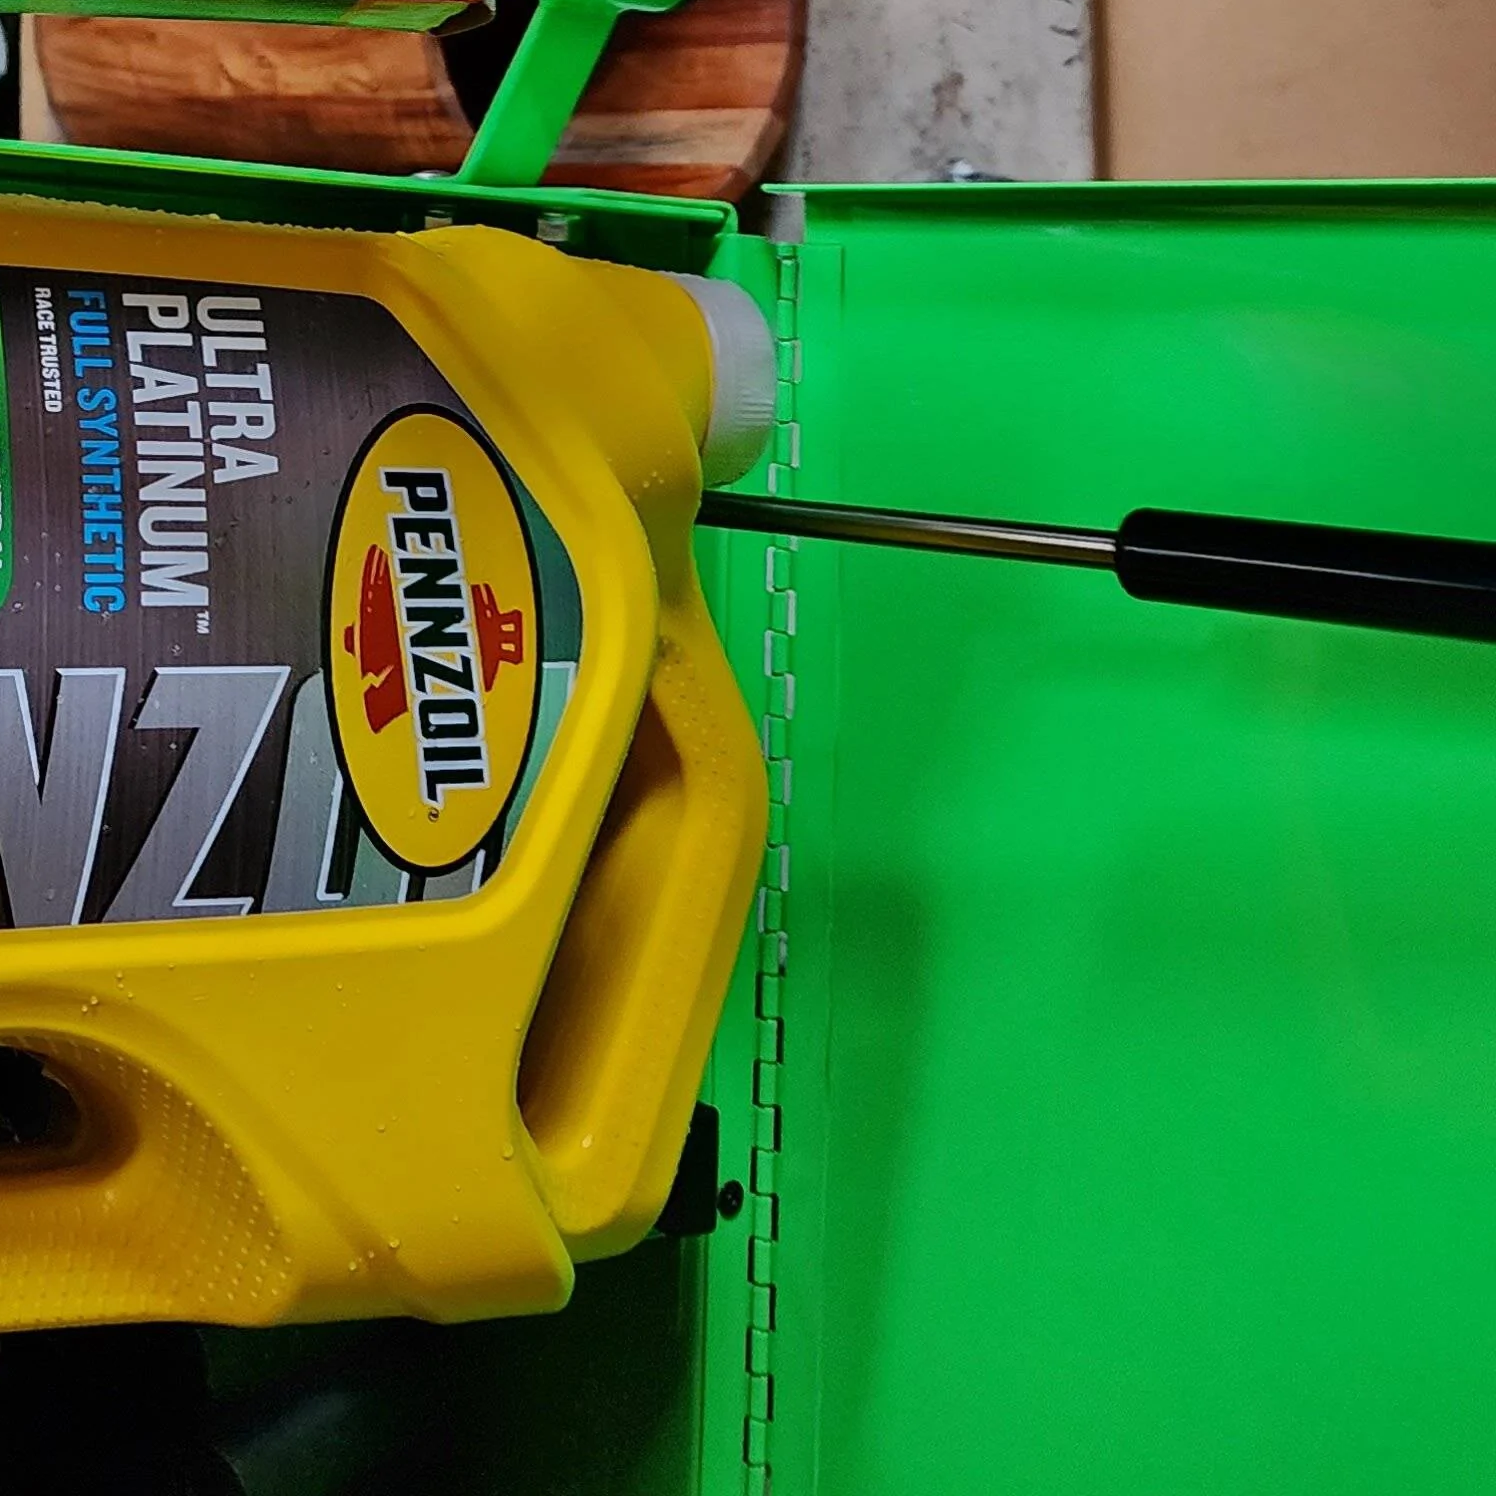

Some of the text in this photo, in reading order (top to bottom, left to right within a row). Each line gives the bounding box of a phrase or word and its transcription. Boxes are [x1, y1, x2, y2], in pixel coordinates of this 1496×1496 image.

[34, 287, 63, 414] RACE TRUSTED
[67, 289, 127, 614] FULL SYNTHETIC
[195, 295, 280, 484] ULTRA
[378, 465, 492, 809] PENNZOIL
